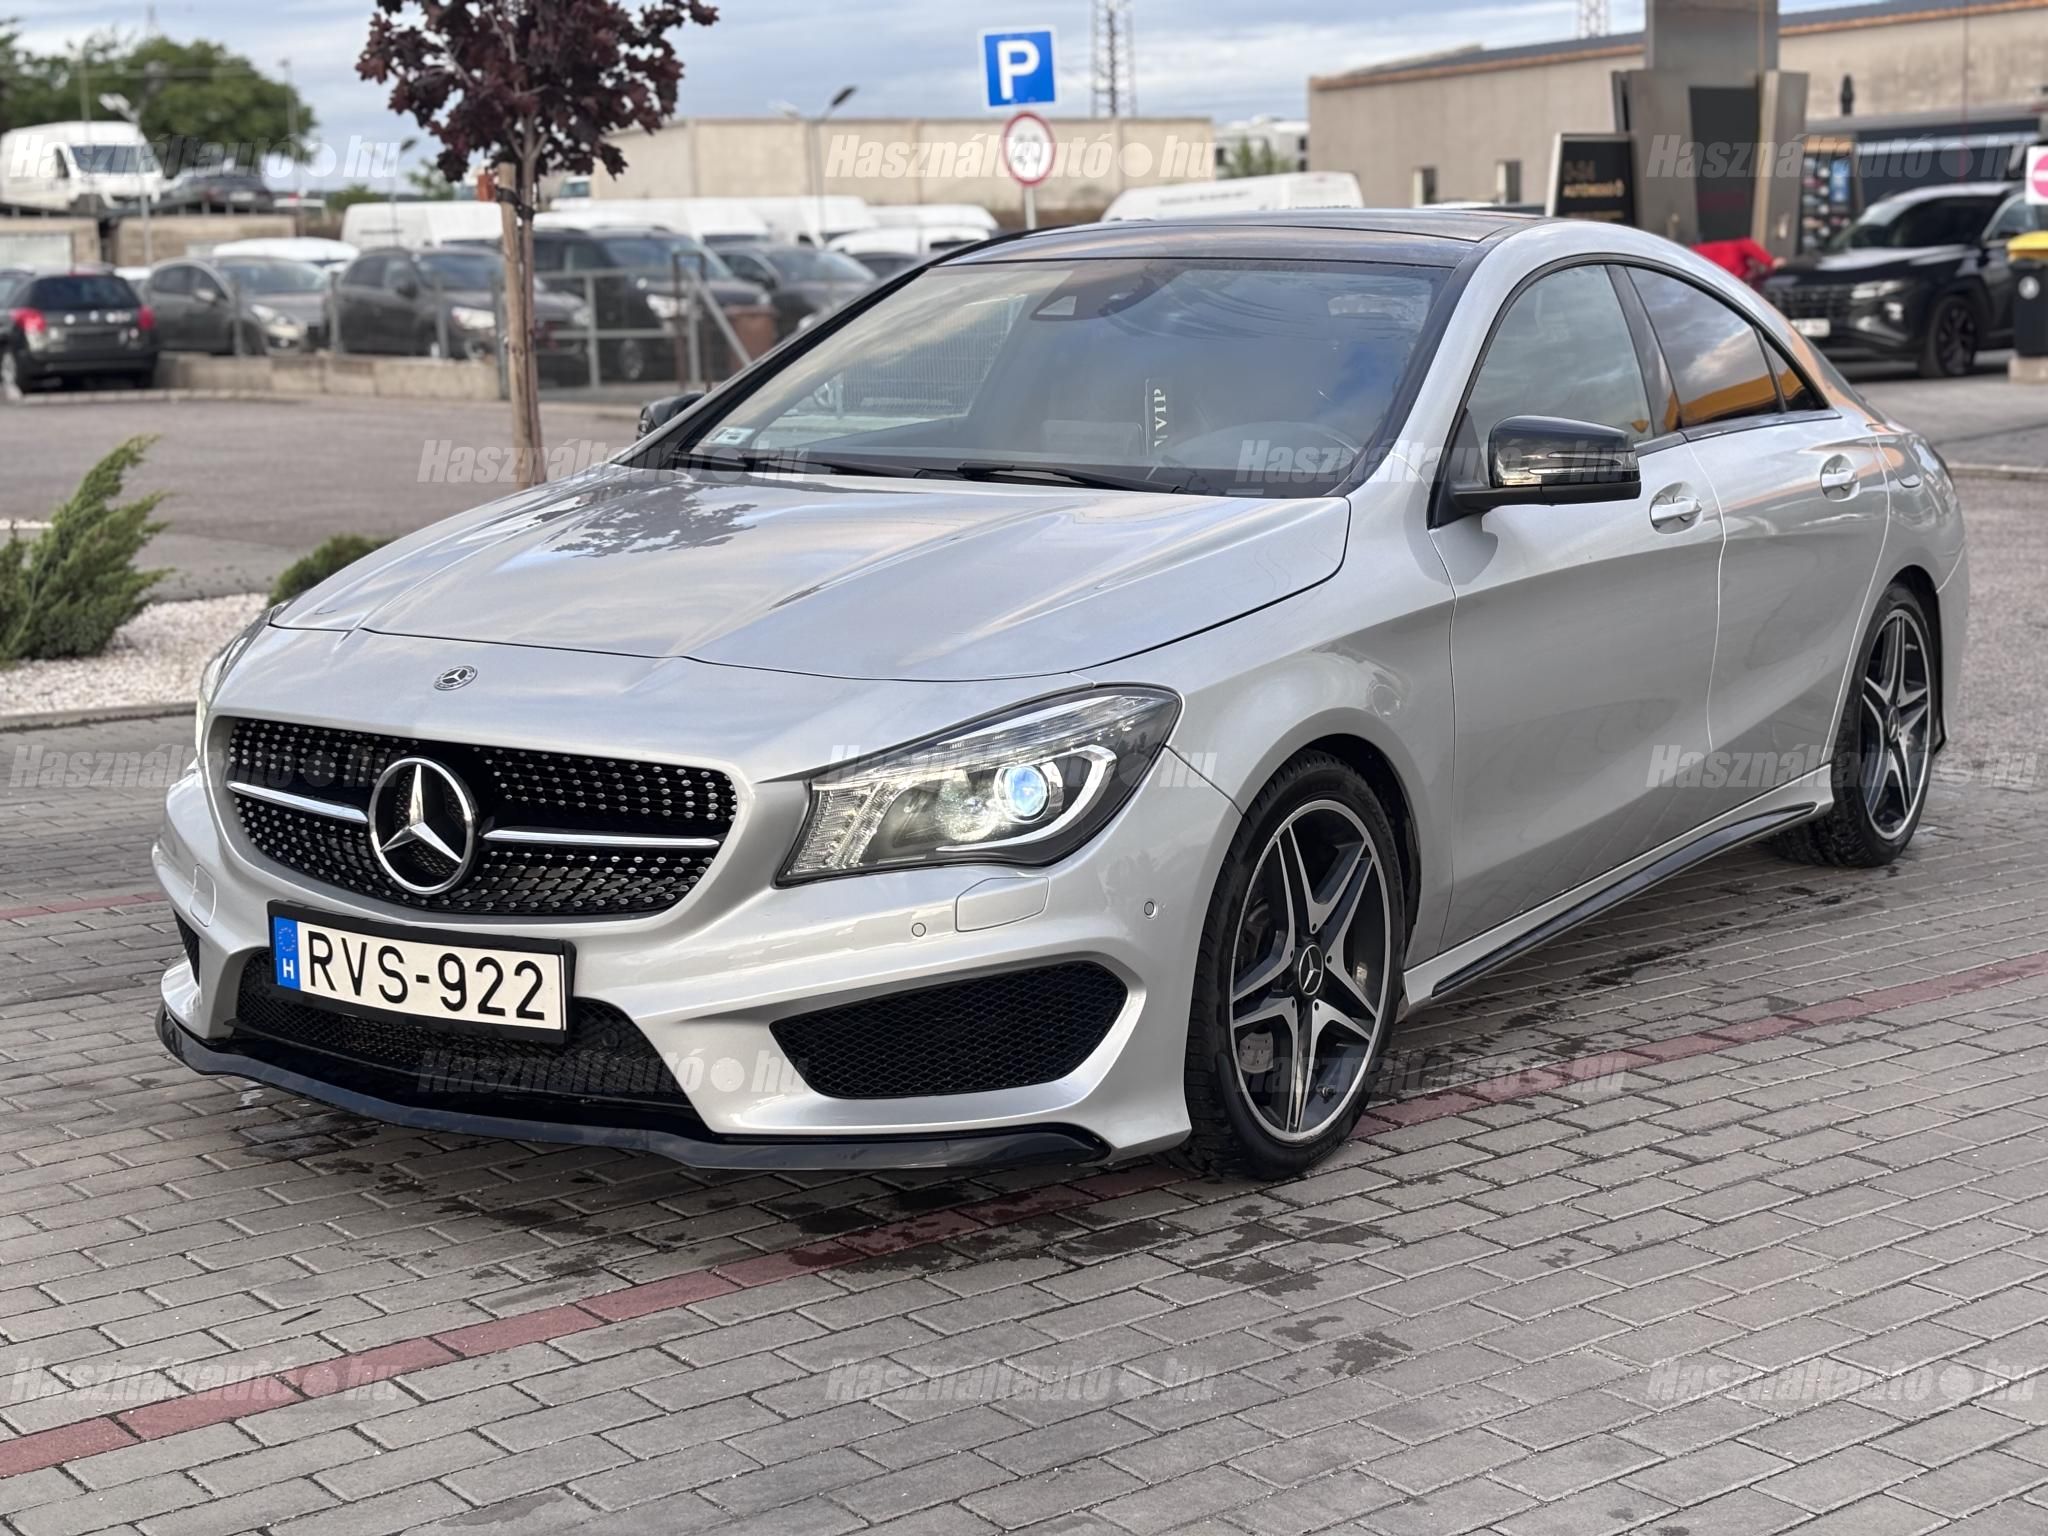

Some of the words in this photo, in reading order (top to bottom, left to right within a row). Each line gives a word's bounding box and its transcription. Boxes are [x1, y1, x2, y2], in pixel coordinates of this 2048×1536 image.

[997, 40, 1040, 100] P
[283, 958, 295, 980] H
[308, 930, 545, 1021] RVS-922
